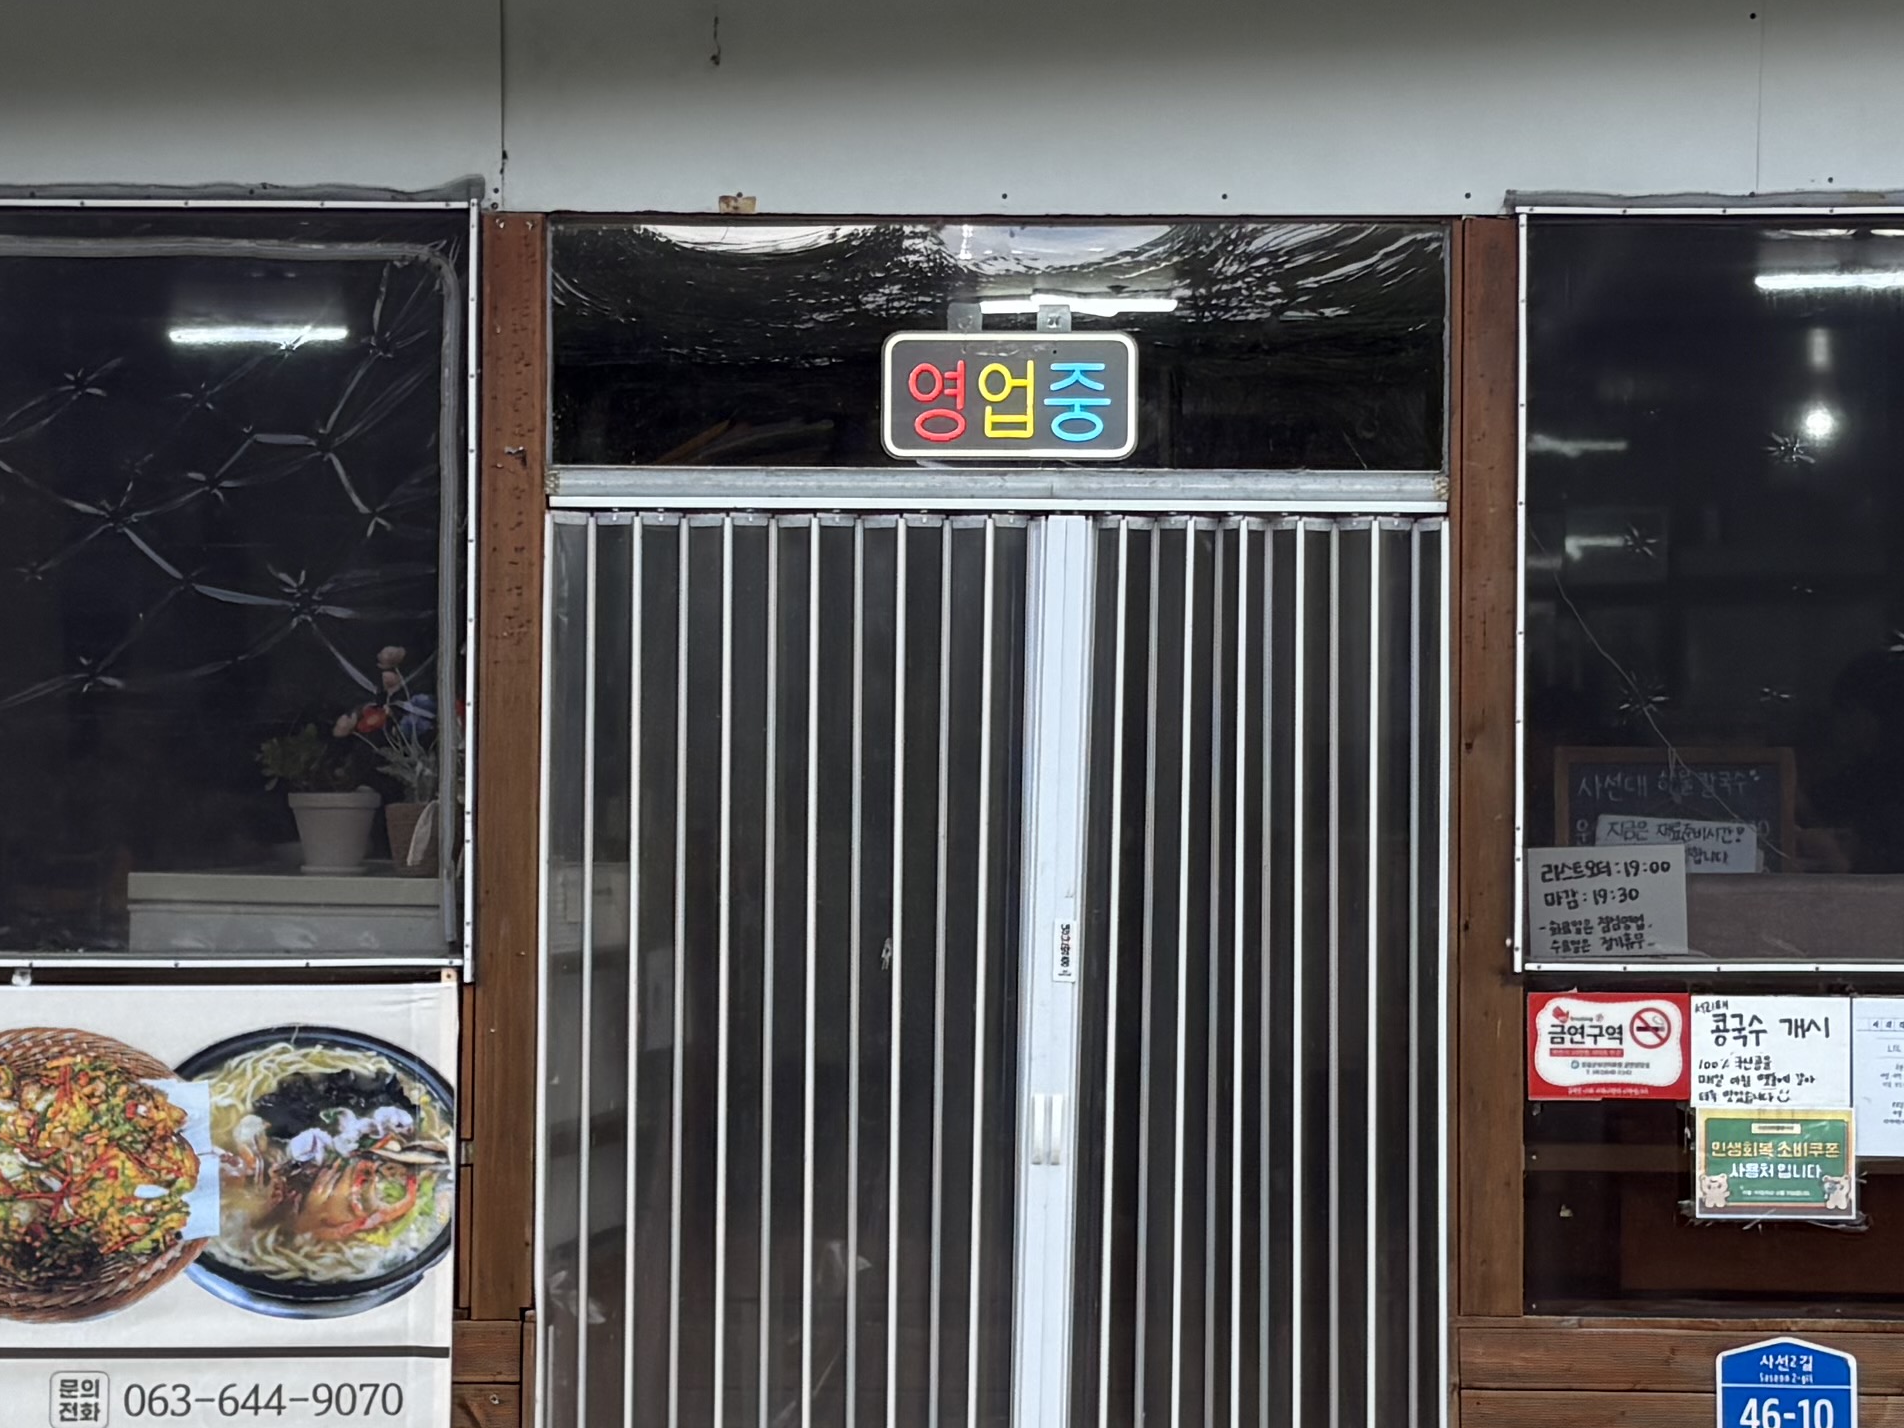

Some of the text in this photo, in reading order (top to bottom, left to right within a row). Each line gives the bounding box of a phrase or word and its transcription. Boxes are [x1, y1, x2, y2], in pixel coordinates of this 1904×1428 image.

[908, 359, 1112, 443] 영업중
[1606, 818, 1650, 843] 지금은
[1548, 1024, 1624, 1046] 금연구역
[1710, 1012, 1830, 1048] 콩국수 개시
[1759, 1353, 1814, 1373] 사선2길
[59, 1378, 100, 1399] 문의
[123, 1382, 404, 1417] 063-644-9070
[58, 1401, 101, 1423] 전화
